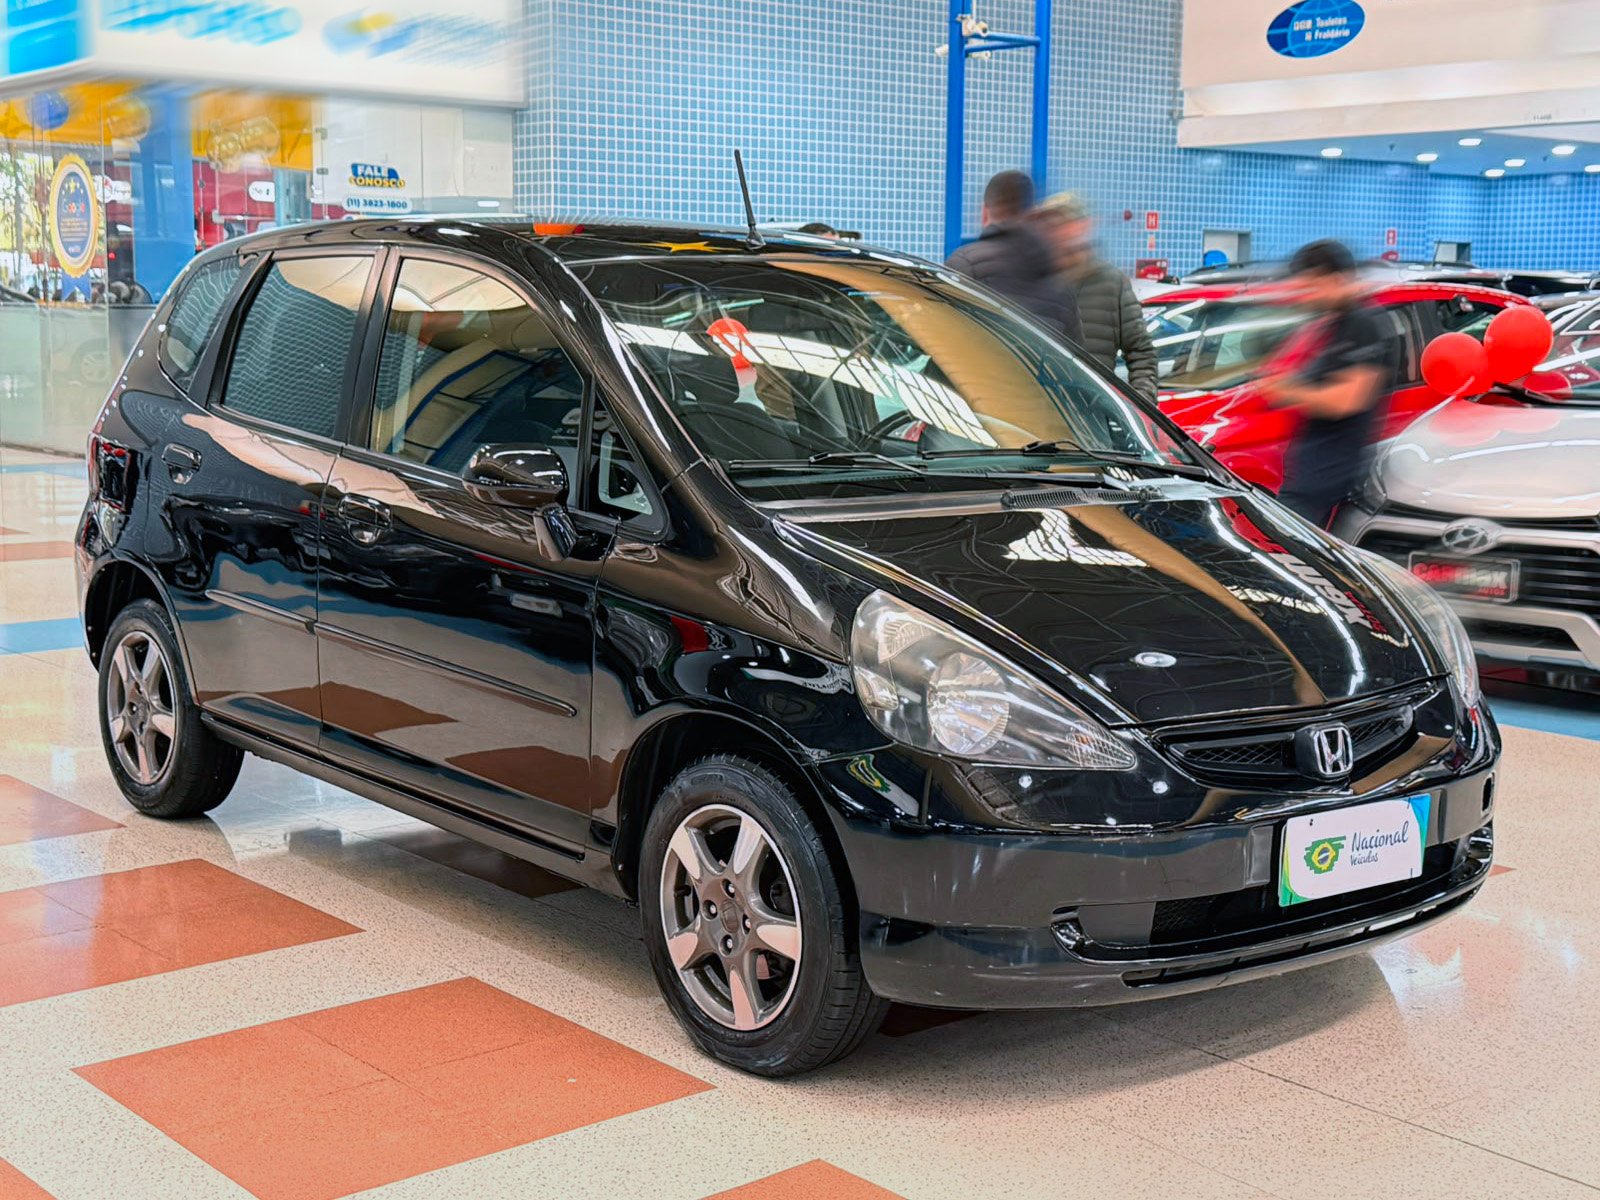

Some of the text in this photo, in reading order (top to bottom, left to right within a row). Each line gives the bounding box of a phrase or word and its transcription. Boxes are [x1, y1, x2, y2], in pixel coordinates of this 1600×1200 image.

[357, 165, 388, 177] FALE
[349, 177, 405, 188] CONOSCO
[1351, 820, 1409, 852] Nacional
